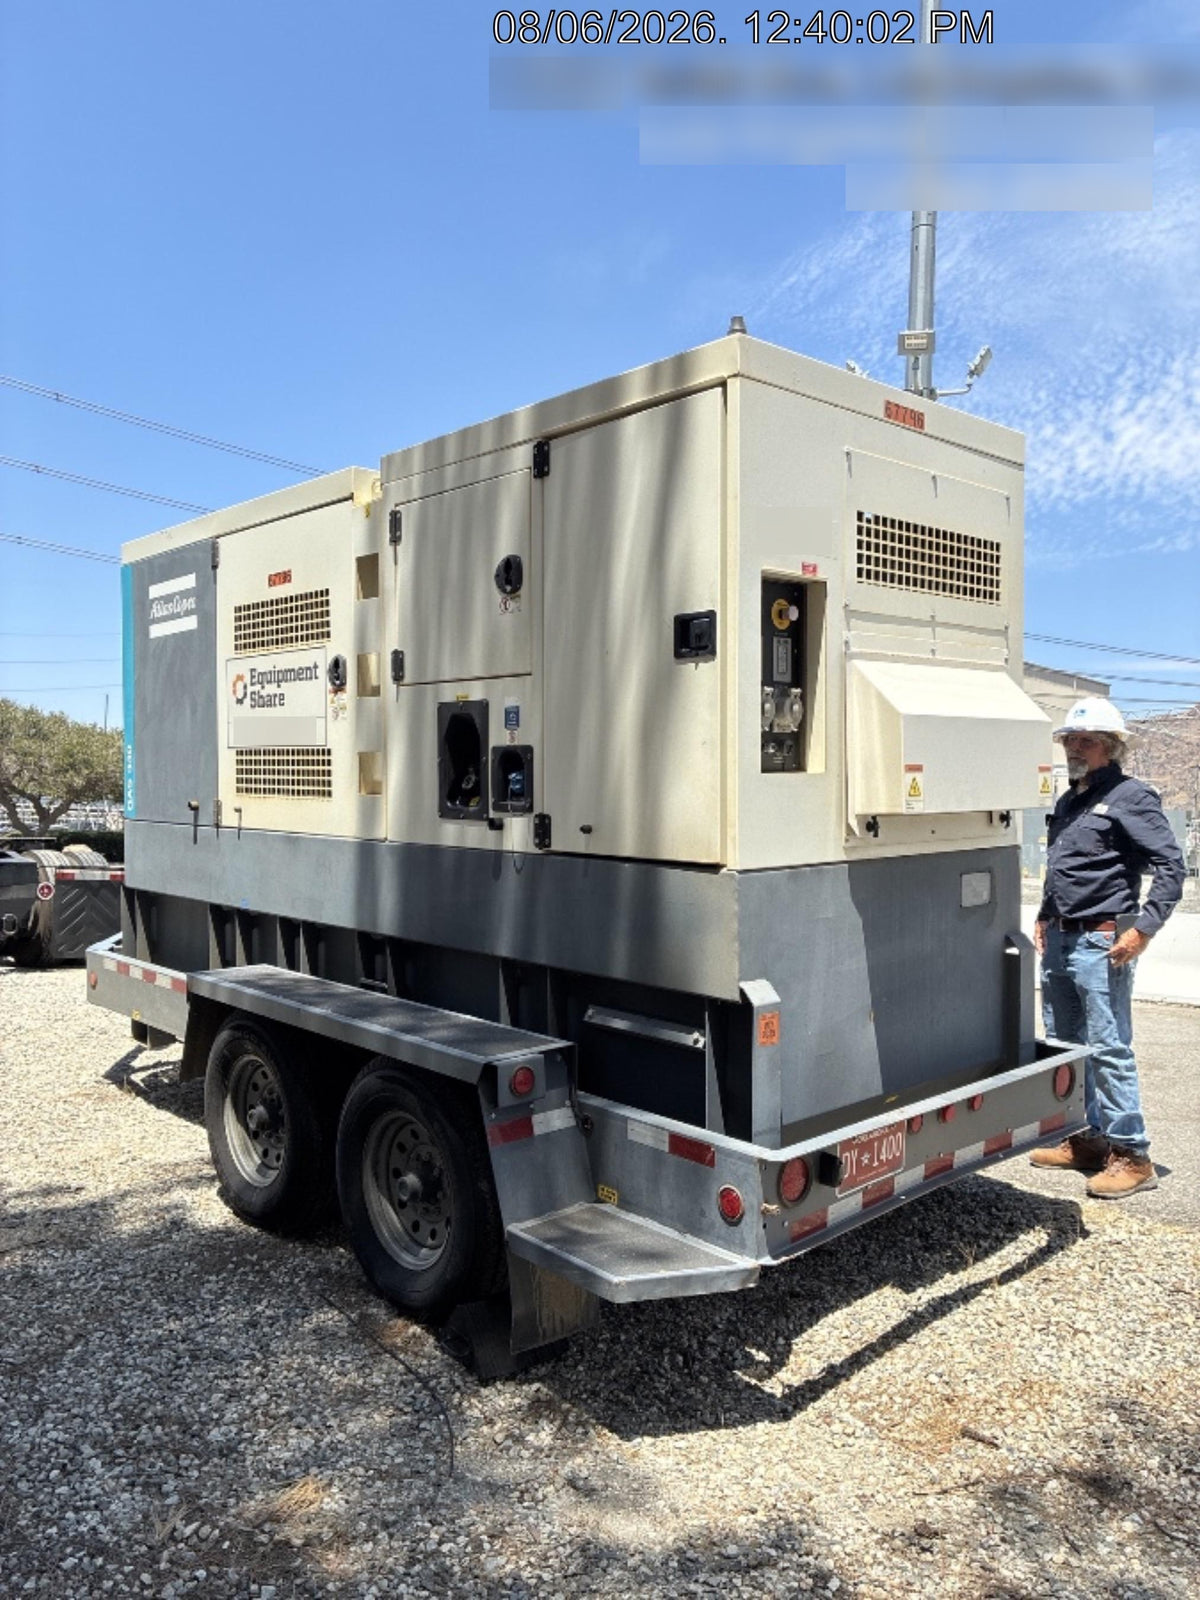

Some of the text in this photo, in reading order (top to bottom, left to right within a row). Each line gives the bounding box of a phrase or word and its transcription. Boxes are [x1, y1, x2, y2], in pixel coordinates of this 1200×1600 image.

[884, 400, 925, 430] 67796
[250, 661, 319, 689] Equipment
[249, 691, 286, 709] Share
[872, 1131, 903, 1168] 1400
